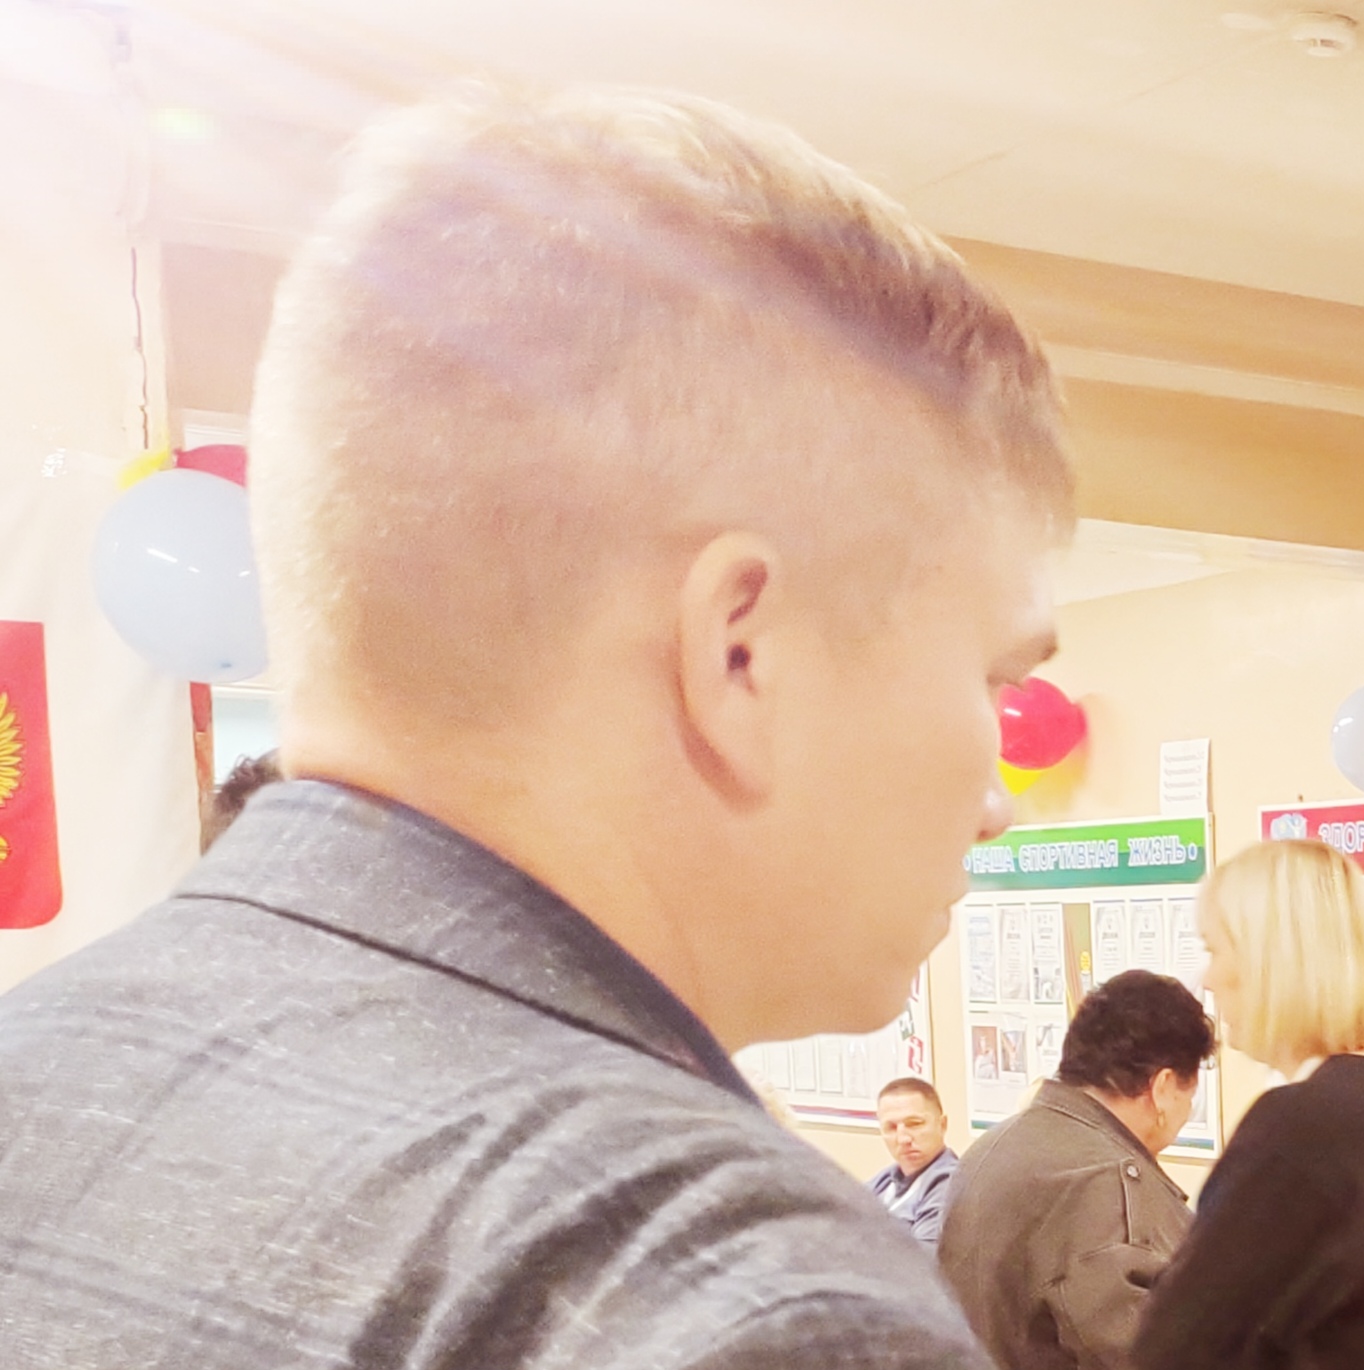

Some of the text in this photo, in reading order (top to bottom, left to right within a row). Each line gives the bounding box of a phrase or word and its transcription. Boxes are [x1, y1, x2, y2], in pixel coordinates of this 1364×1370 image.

[972, 835, 1186, 875] НАША СПОРТИВНАЯ ЖИЗНЬ
